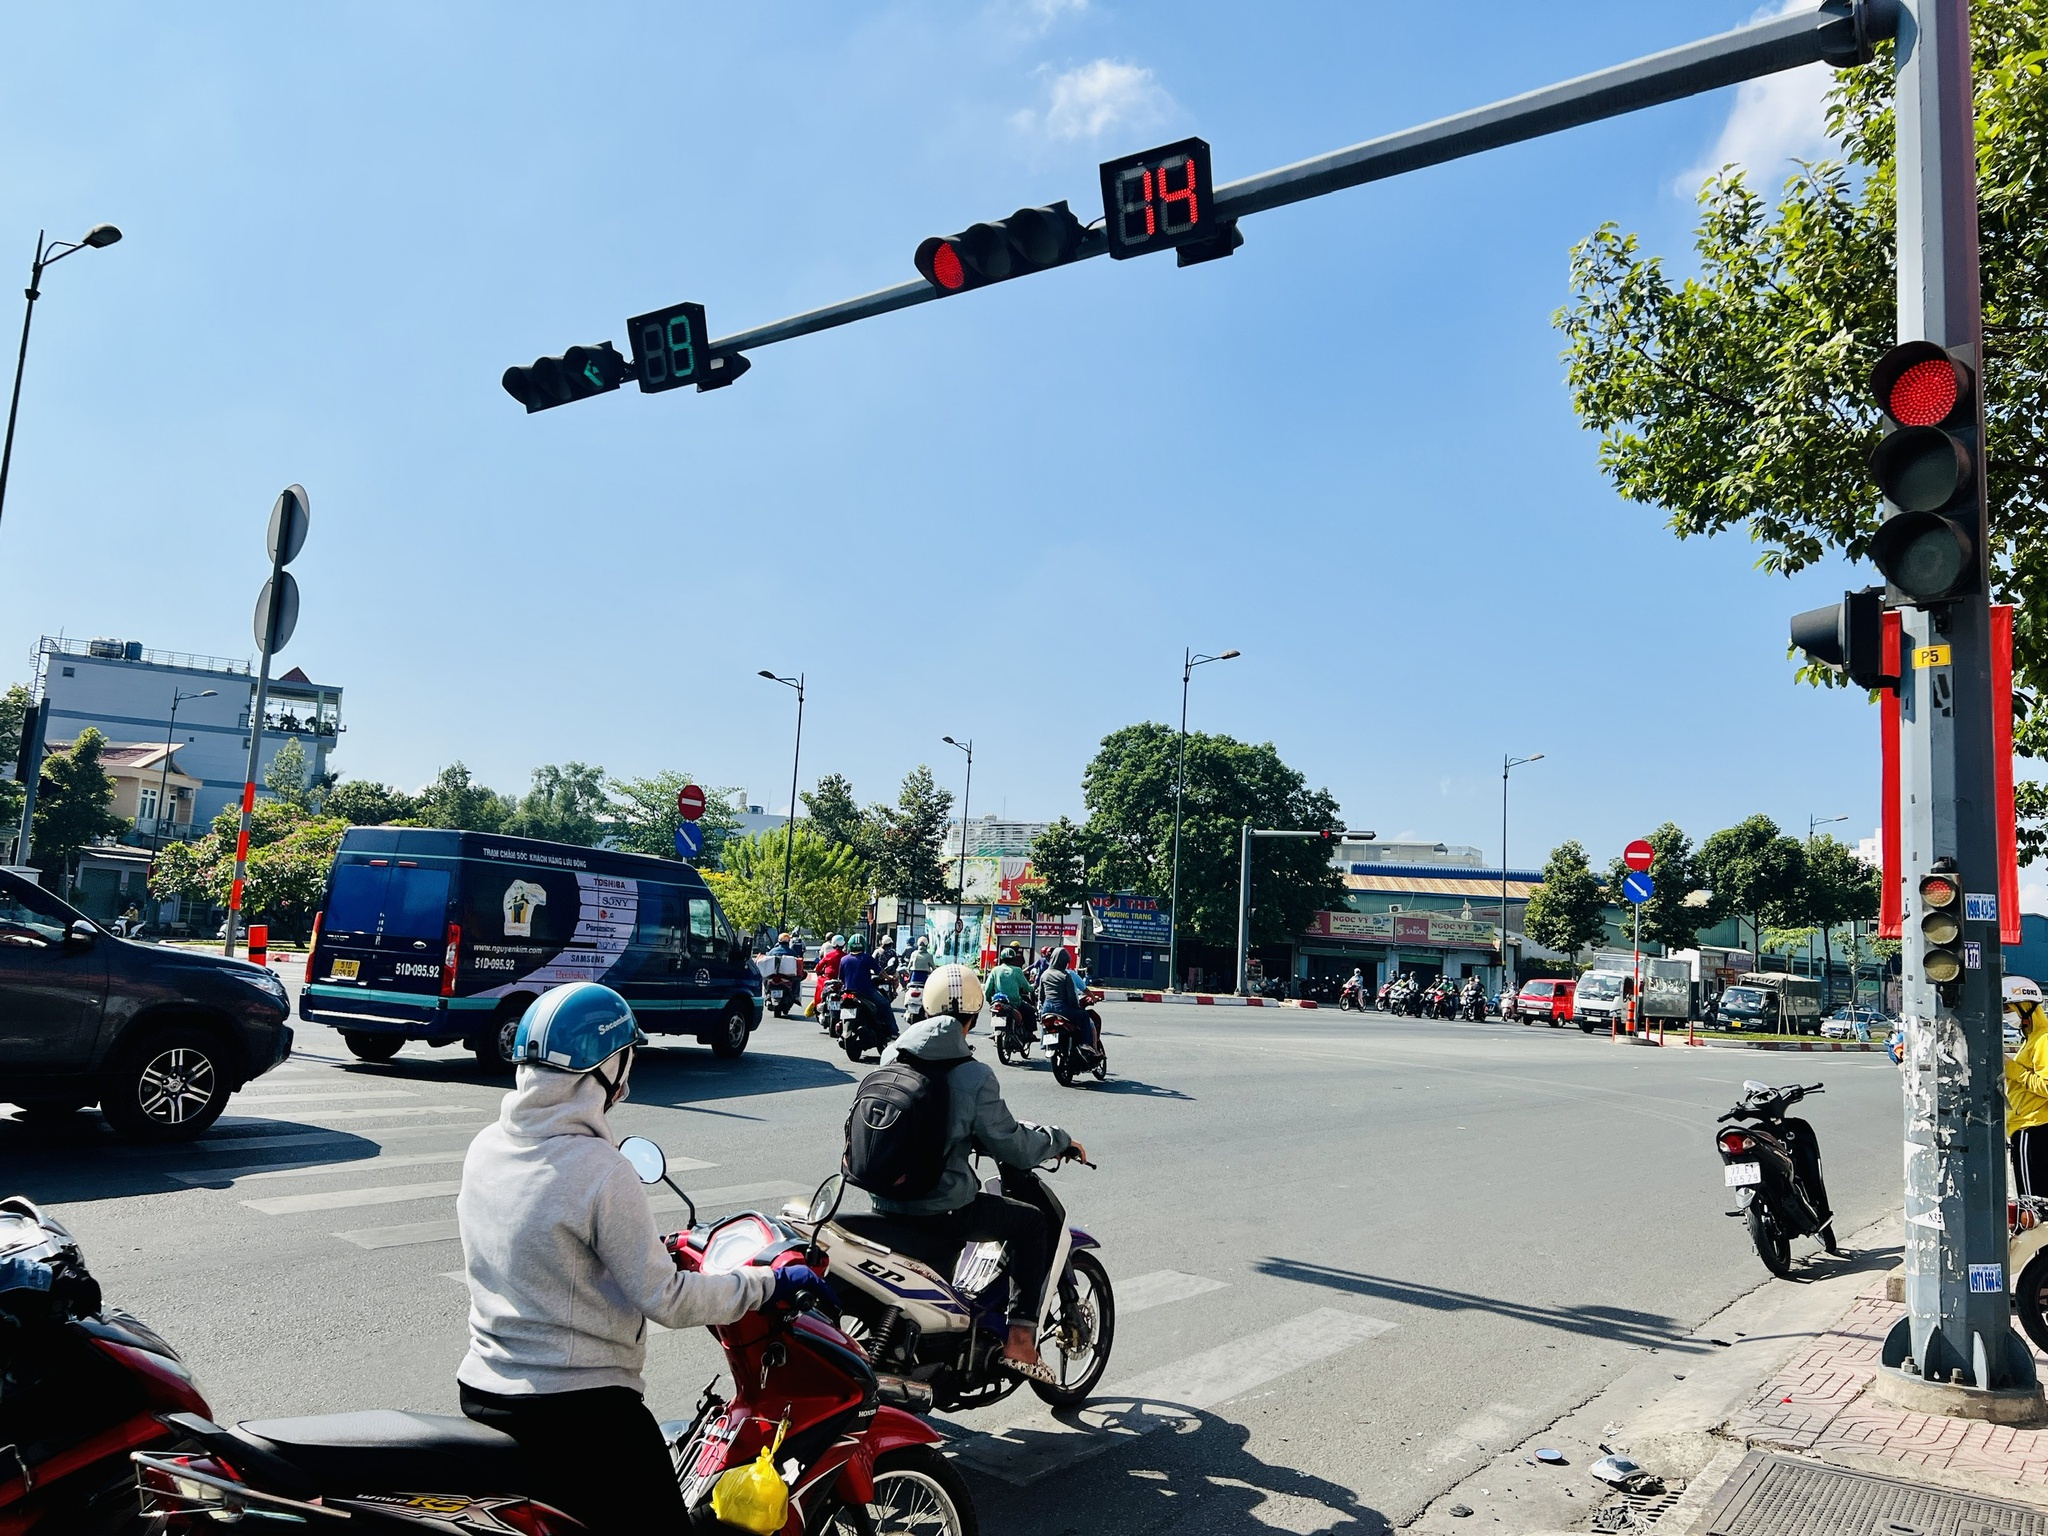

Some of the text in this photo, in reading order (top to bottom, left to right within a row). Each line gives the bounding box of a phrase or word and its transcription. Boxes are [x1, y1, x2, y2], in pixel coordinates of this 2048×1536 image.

[1142, 158, 1198, 236] 14
[667, 314, 695, 377] 9
[1921, 650, 1939, 664] P5
[593, 878, 626, 890] TOSHIBA
[602, 896, 629, 907] SONY
[473, 944, 543, 954] www.nguyenkim.com
[474, 957, 515, 970] 51D-095.92
[570, 954, 605, 964] SAMSUNG
[395, 962, 440, 977] 51D-095.92
[2021, 988, 2038, 996] CONS
[857, 1258, 906, 1283] GP
[858, 1408, 877, 1418] HONDA
